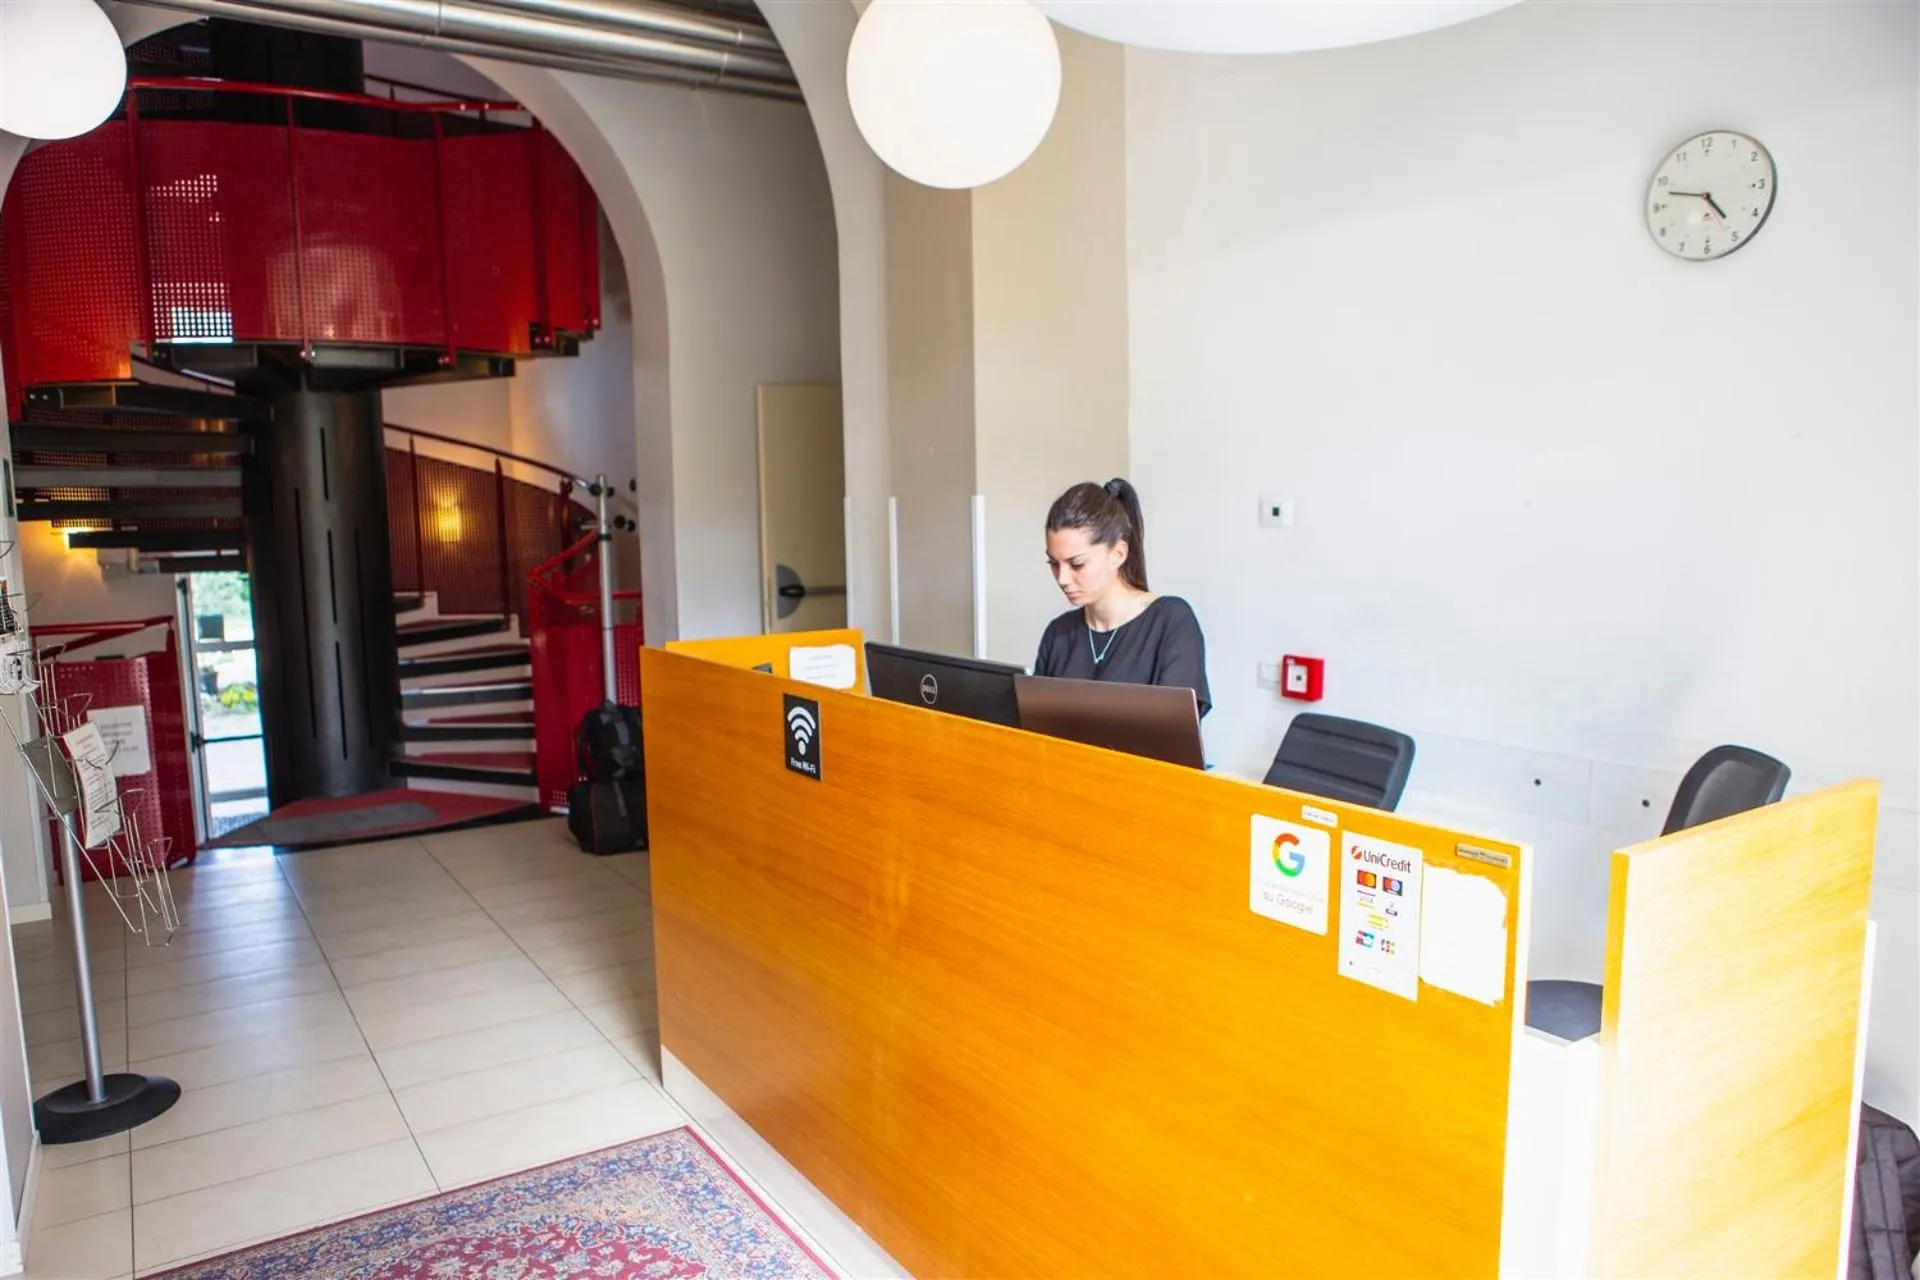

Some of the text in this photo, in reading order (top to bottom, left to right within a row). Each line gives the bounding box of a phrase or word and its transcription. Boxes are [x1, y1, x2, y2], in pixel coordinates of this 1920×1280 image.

[1701, 137, 1712, 148] 12
[1731, 140, 1737, 148] 1
[1676, 152, 1687, 162] 11
[1750, 151, 1758, 161] 2
[1657, 176, 1669, 186] 10
[1758, 179, 1765, 189] 3
[1653, 203, 1660, 213] 9
[1752, 207, 1759, 217] 4
[1660, 227, 1666, 237] 8
[1731, 231, 1739, 242] 5
[1679, 242, 1685, 252] 7
[1703, 244, 1711, 254] 6
[790, 756, 802, 770] Free
[1271, 832, 1305, 877] G
[1364, 849, 1411, 874] UniCredit
[1277, 893, 1314, 914] Google
